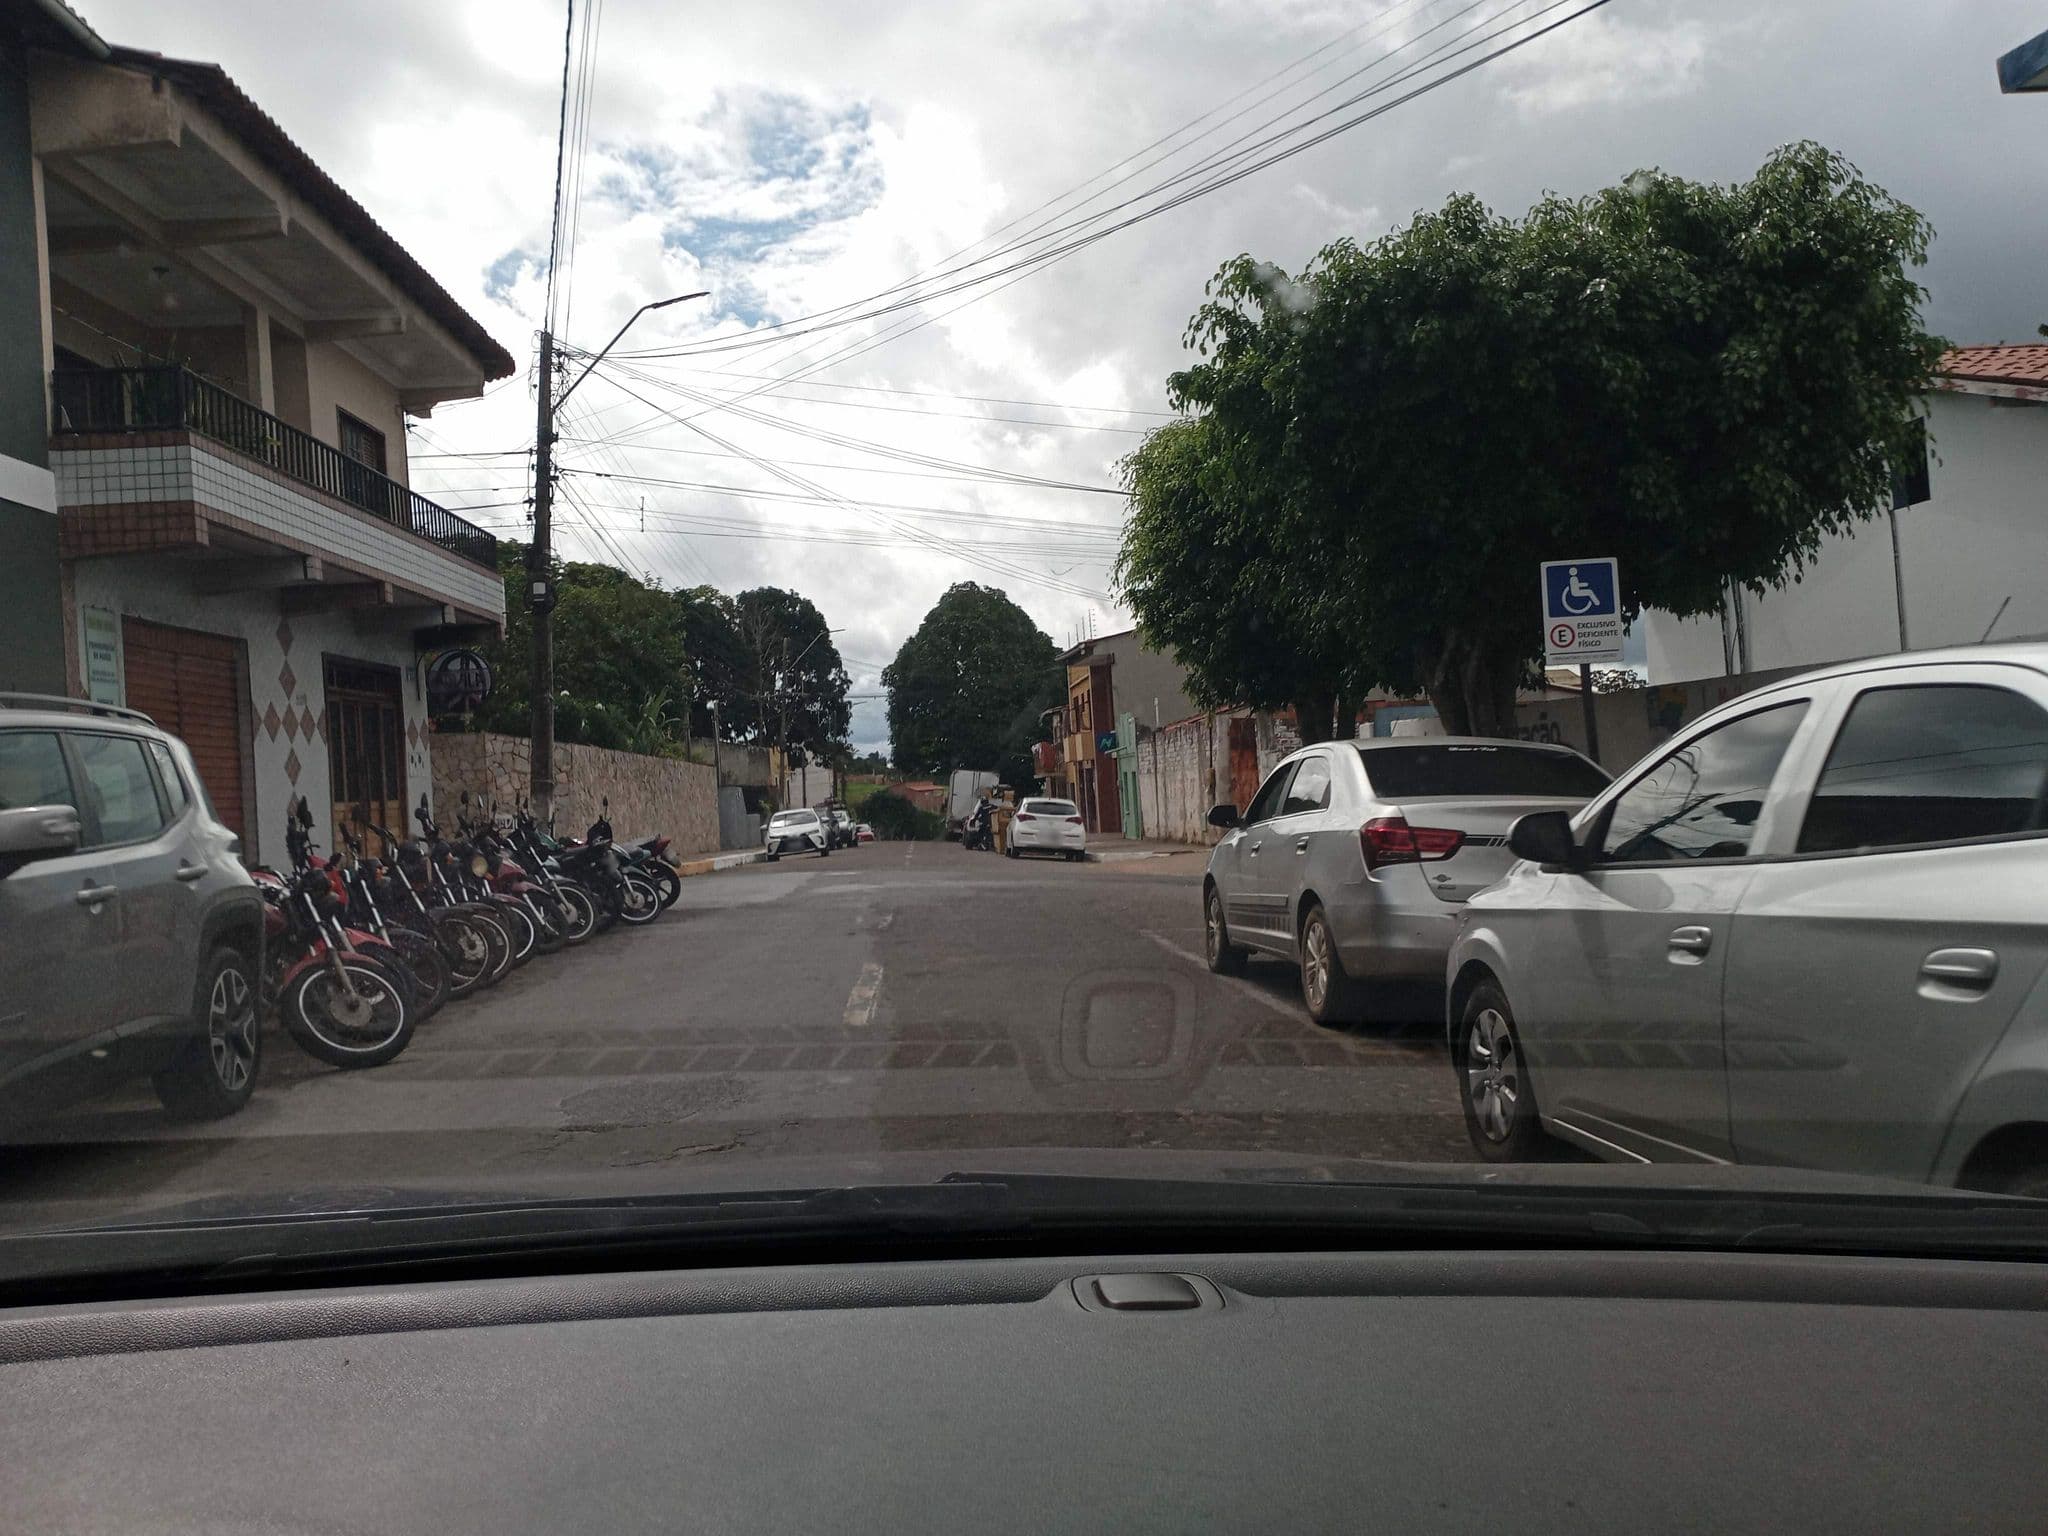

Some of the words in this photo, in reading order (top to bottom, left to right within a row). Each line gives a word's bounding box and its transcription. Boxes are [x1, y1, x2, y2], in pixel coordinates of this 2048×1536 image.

[1577, 621, 1616, 629] EXCLUSIVO
[1558, 630, 1567, 642] E
[1577, 630, 1618, 638] DEFICIENTE
